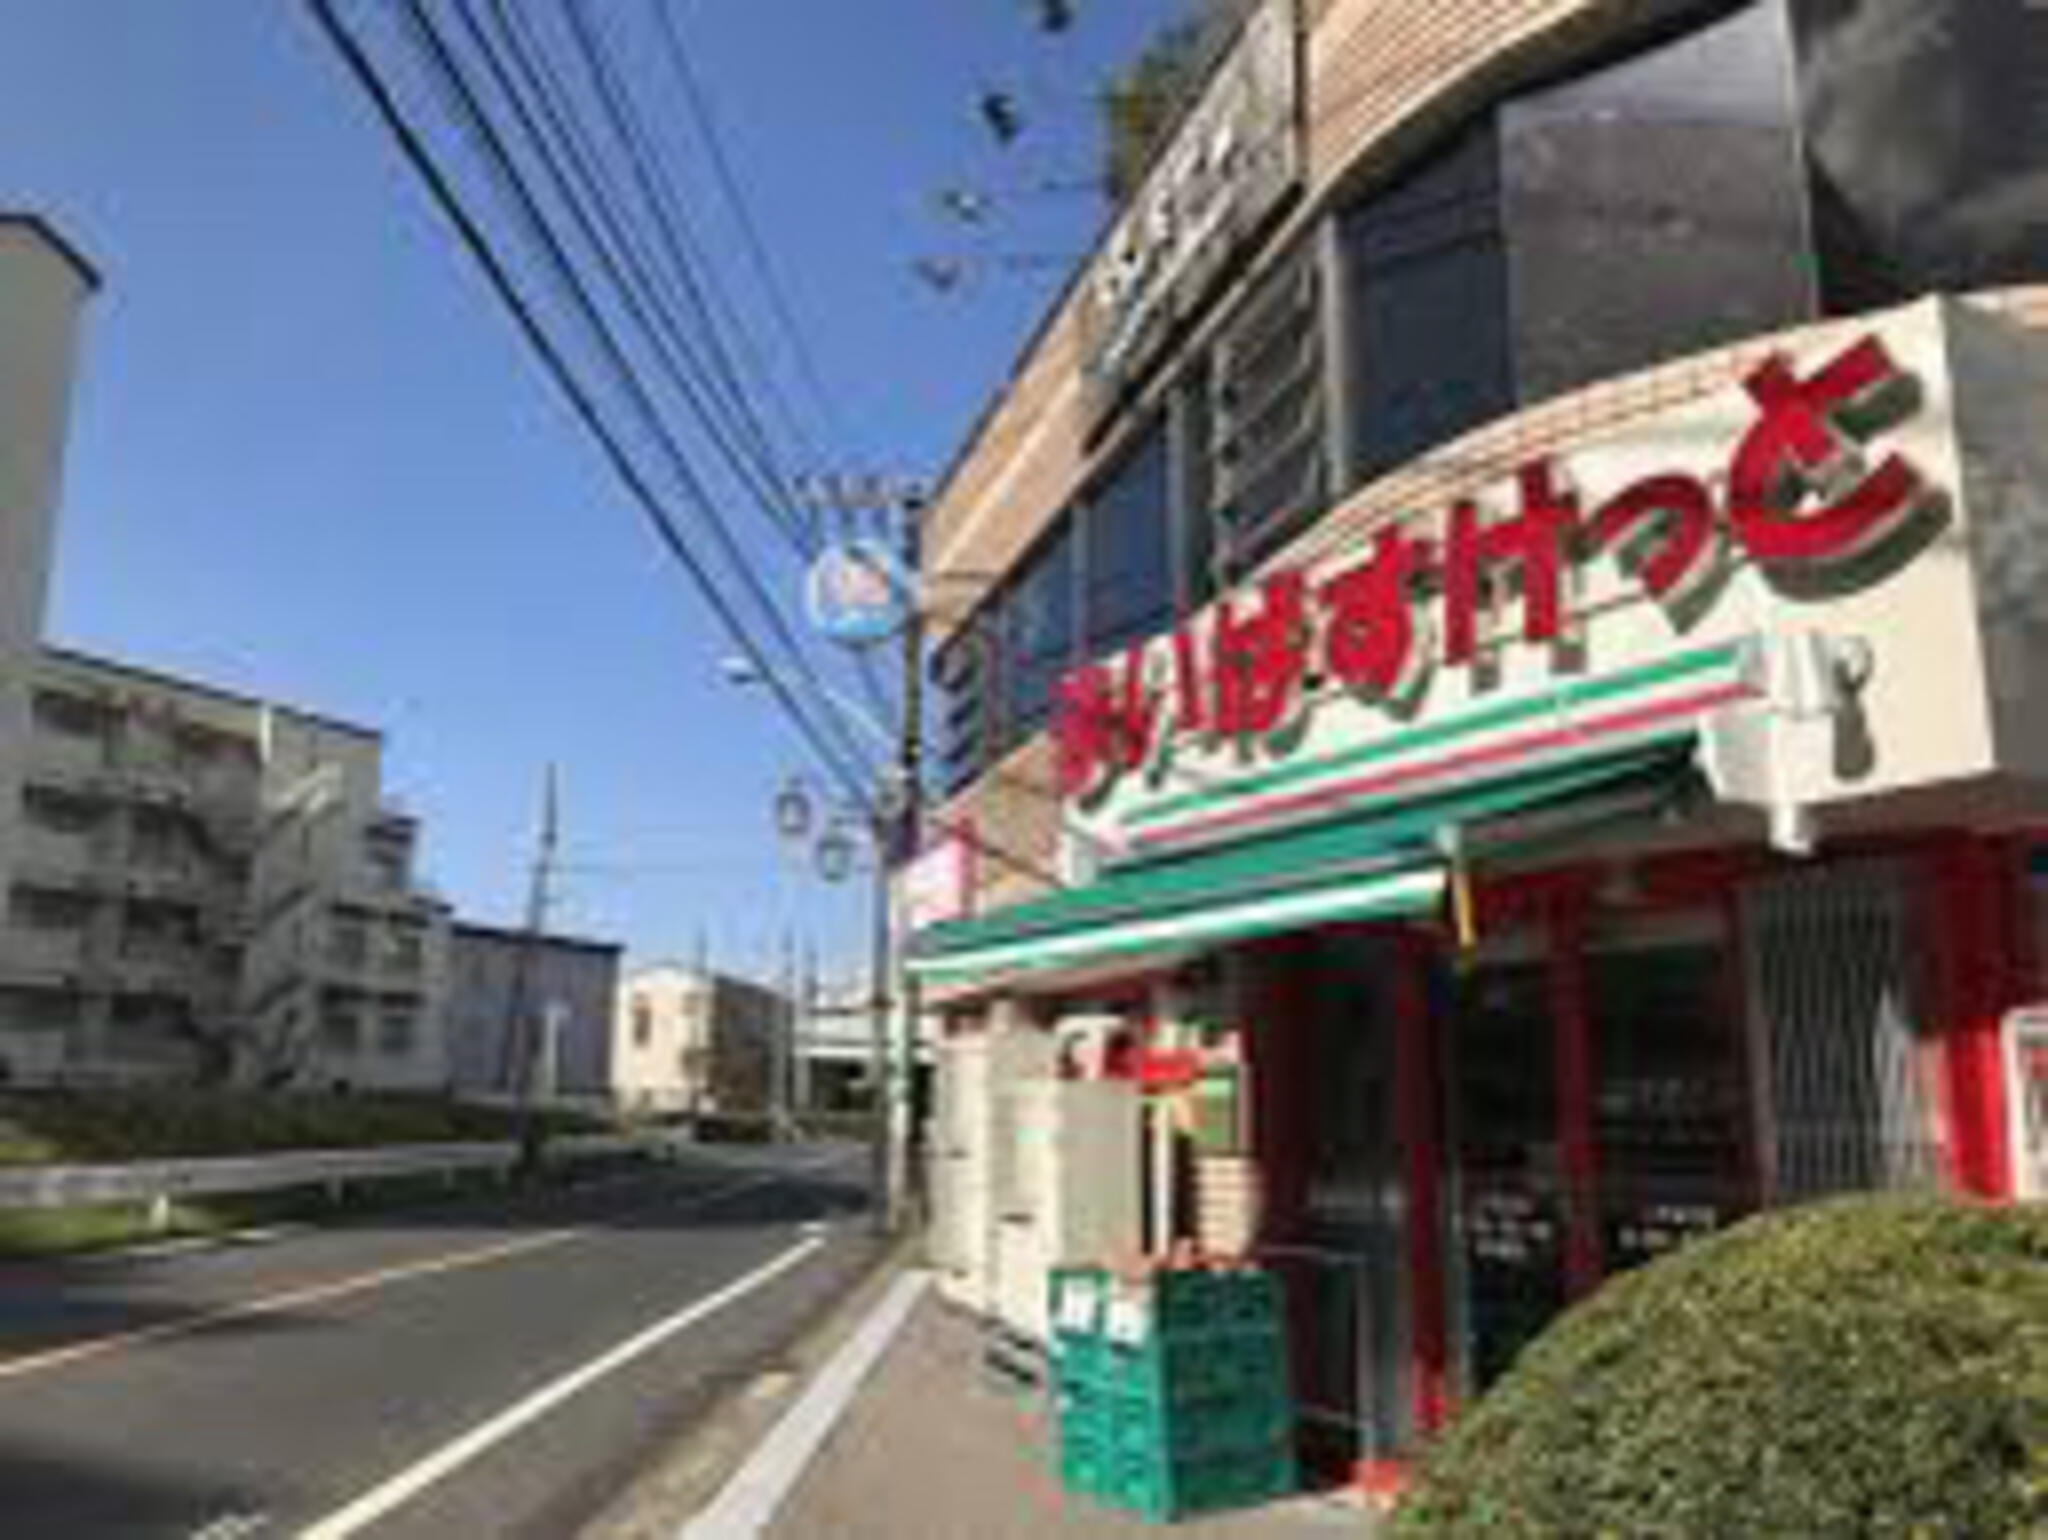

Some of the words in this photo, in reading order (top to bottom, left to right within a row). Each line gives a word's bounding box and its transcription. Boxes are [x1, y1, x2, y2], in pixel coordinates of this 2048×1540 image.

[1052, 333, 1914, 794] まいばすけっと
